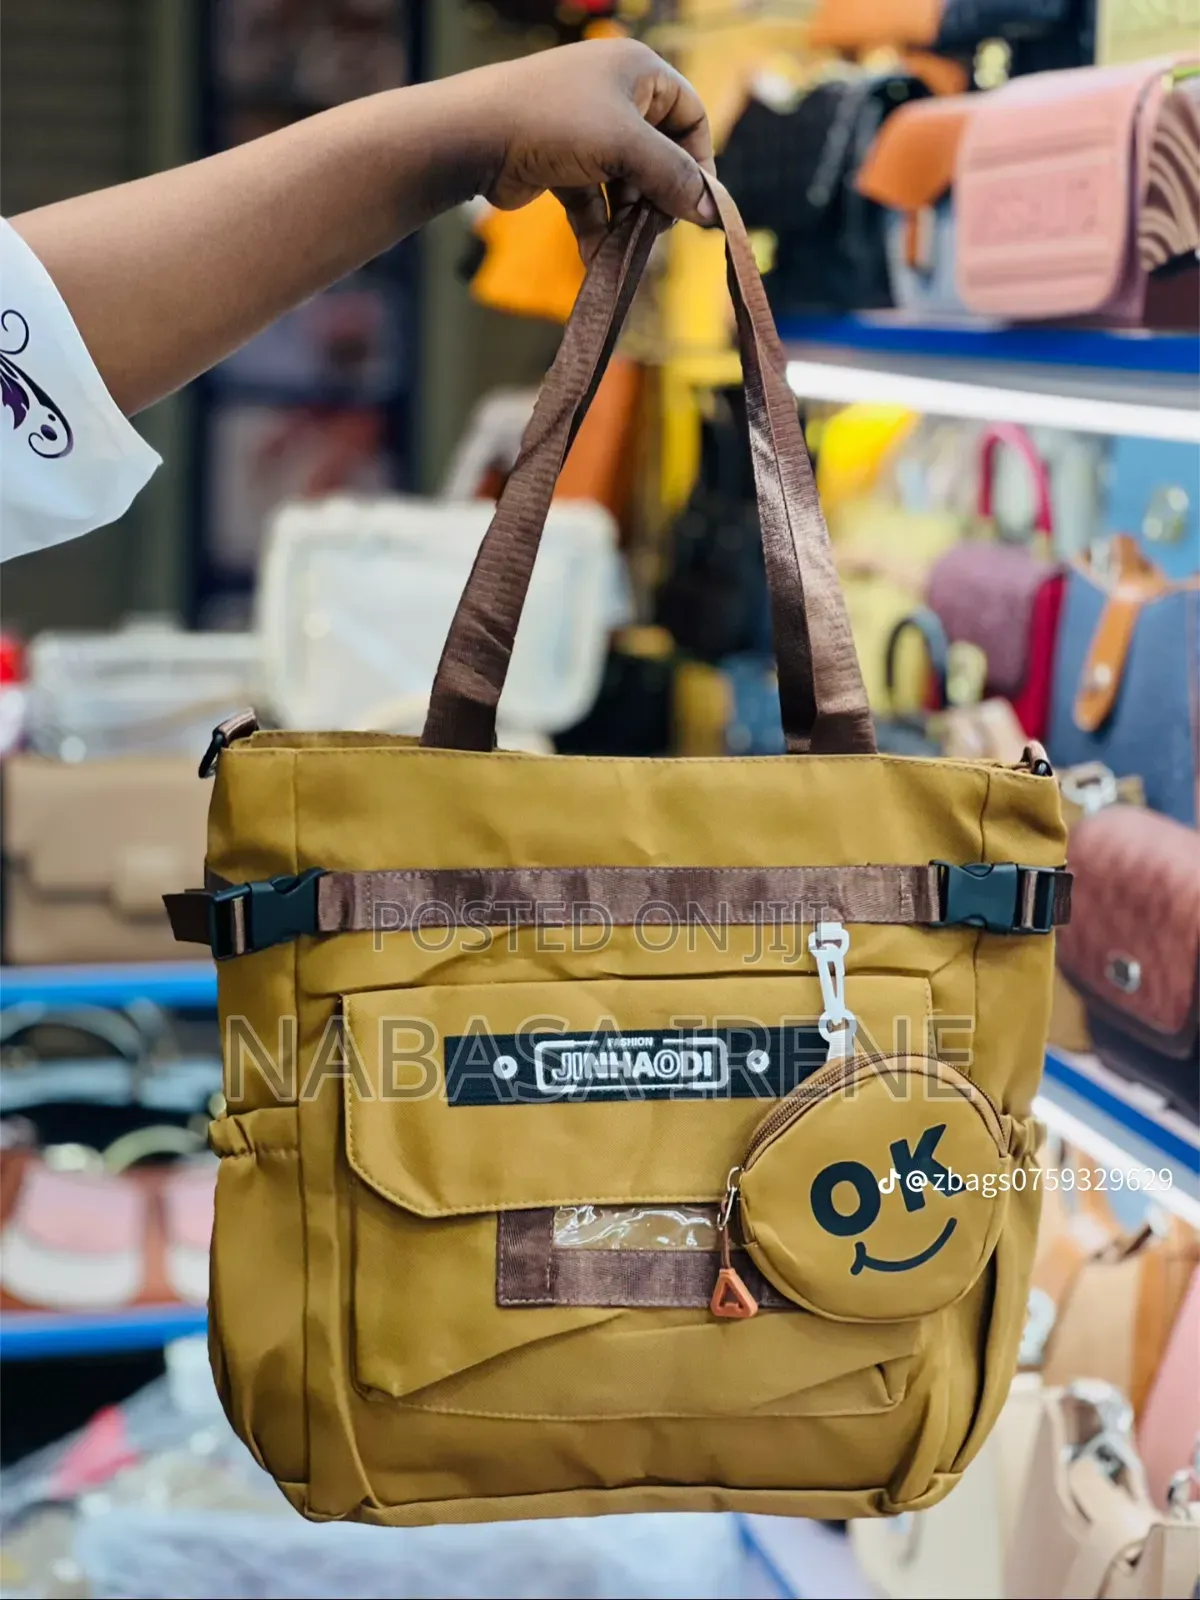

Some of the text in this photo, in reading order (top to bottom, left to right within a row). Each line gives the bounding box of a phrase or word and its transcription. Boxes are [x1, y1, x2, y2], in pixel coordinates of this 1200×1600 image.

[607, 1036, 654, 1047] FASHION
[551, 1049, 713, 1080] JINHAODI
[810, 1123, 966, 1236] OK
